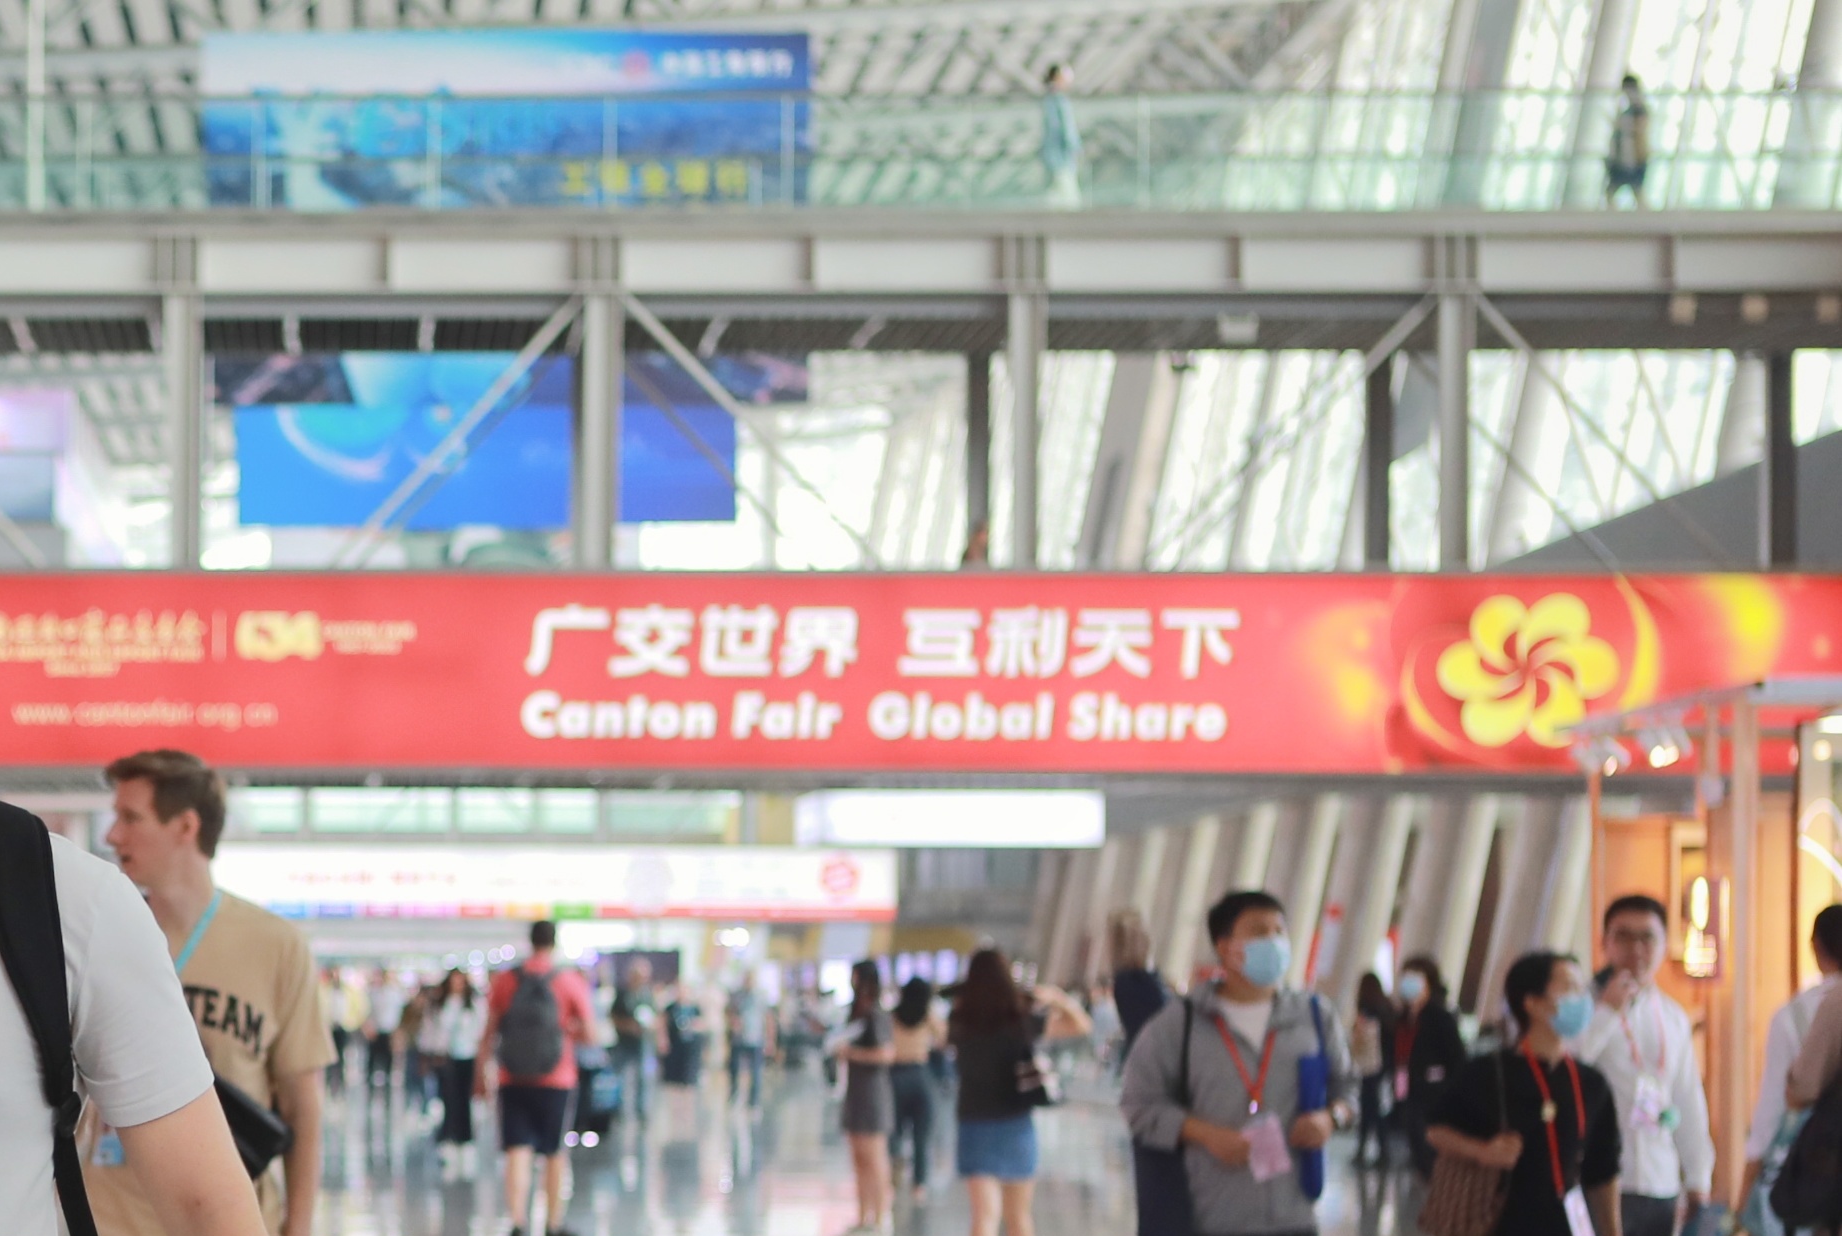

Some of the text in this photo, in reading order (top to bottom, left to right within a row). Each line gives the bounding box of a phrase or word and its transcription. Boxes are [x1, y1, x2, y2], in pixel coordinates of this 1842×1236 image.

[523, 603, 1241, 680] 广交世界 互利天下
[519, 690, 1228, 741] Canton Fair Global Share
[183, 985, 264, 1057] TEAM
